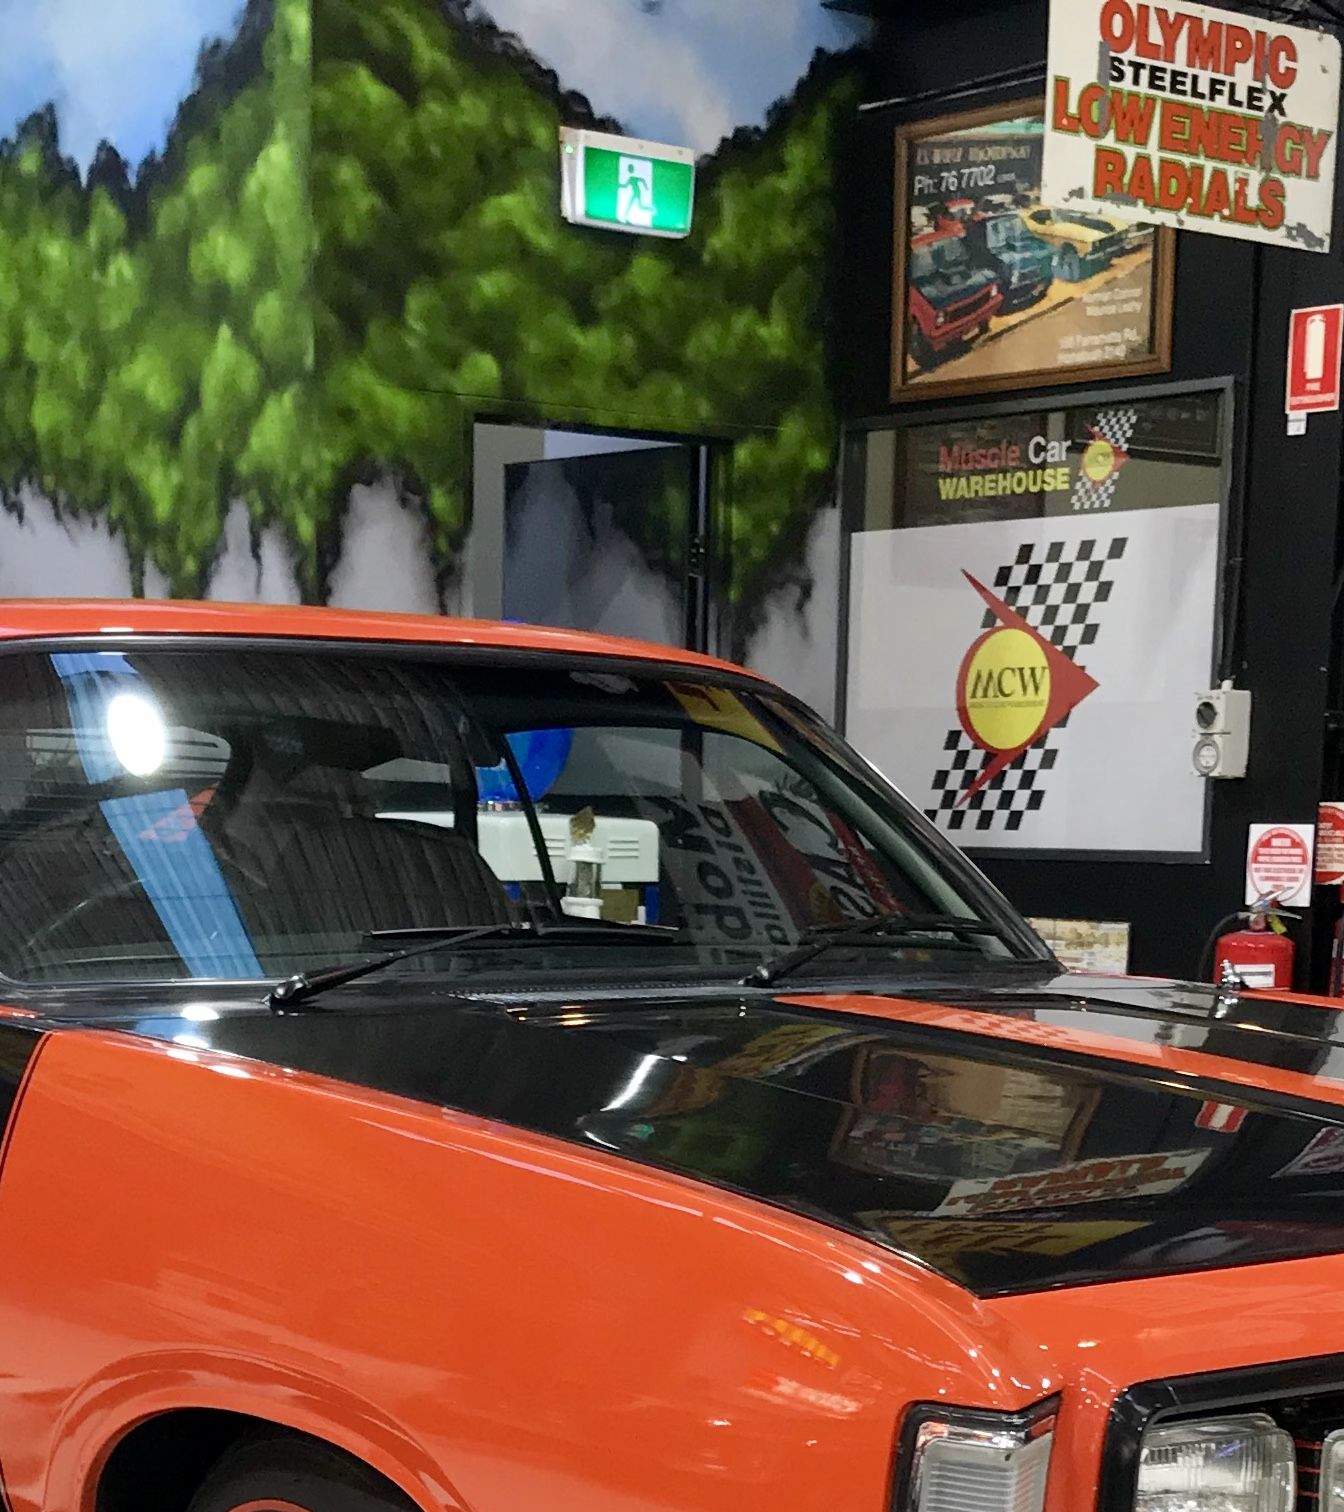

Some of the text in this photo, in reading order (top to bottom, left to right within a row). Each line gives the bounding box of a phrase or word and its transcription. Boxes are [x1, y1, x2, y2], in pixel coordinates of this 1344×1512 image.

[1099, 0, 1298, 89] OLYMPIC
[1052, 75, 1156, 148] LOW
[1108, 56, 1288, 116] STEELFLEX
[1092, 145, 1286, 230] RADIALS
[939, 439, 1021, 471] Muscle
[1028, 435, 1072, 464] Car
[938, 467, 1070, 500] WAREHOUSE
[969, 666, 1048, 699] MCW
